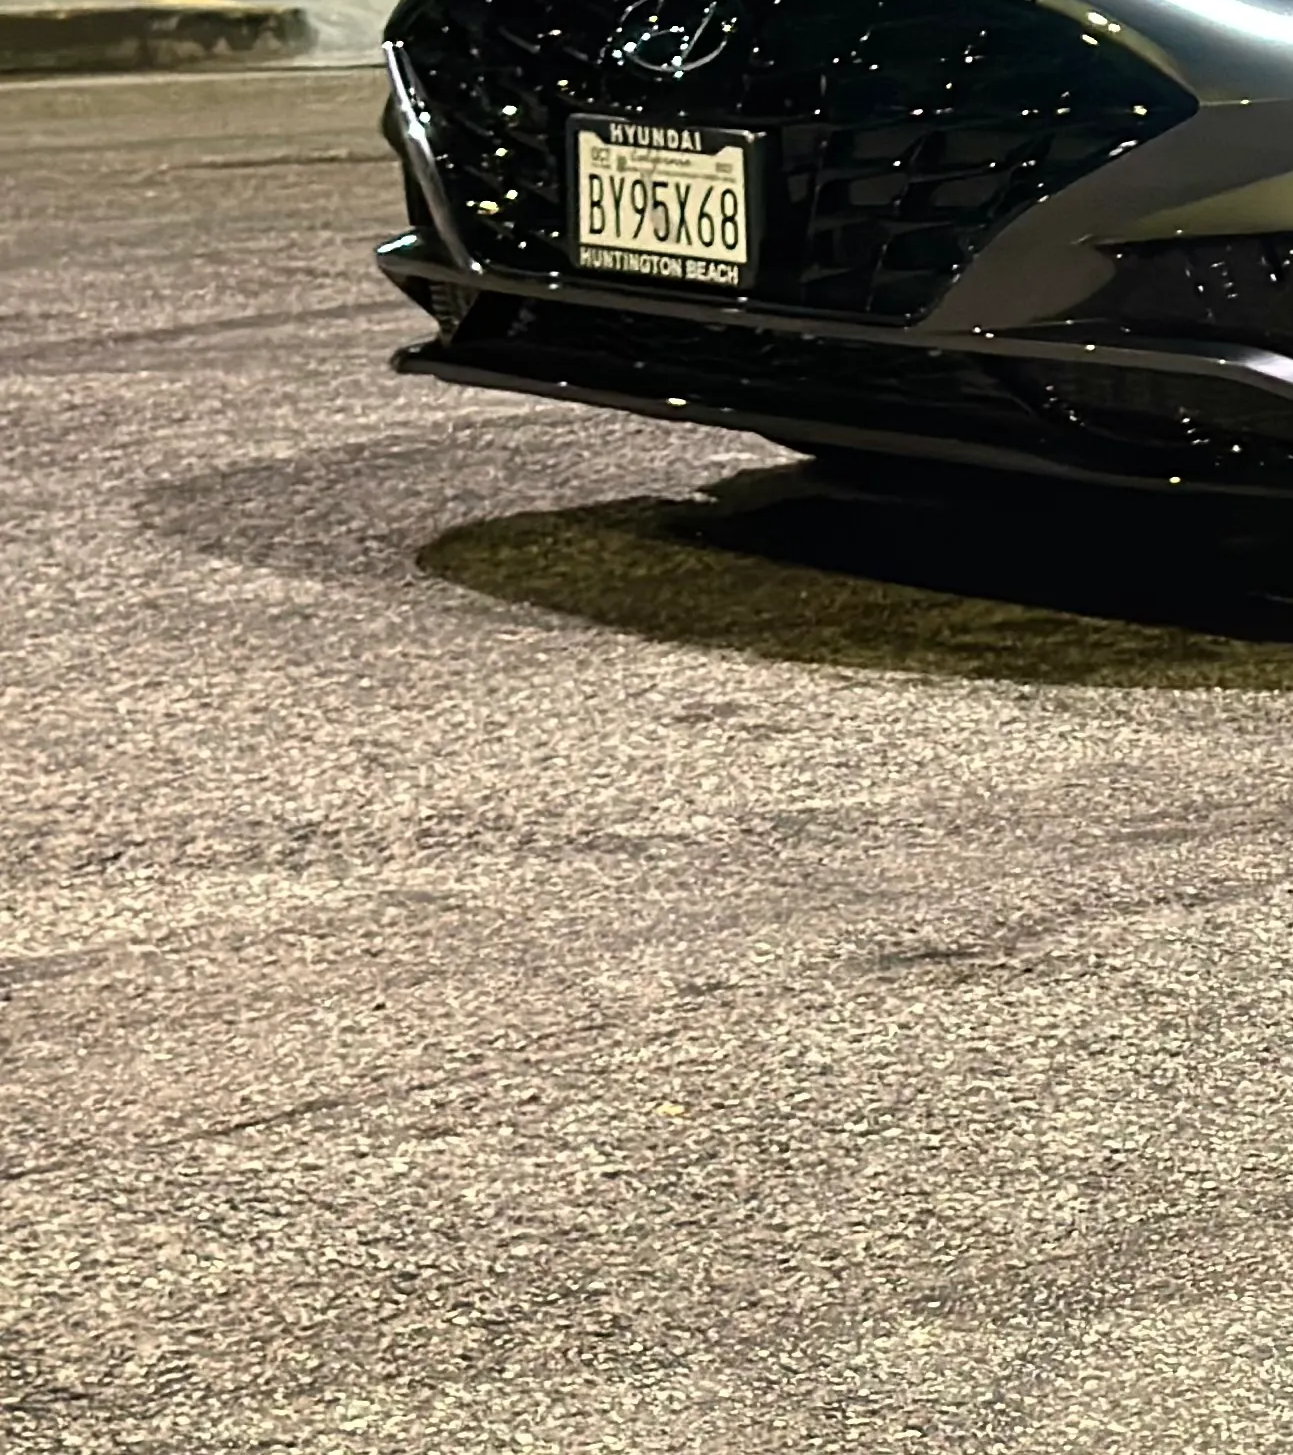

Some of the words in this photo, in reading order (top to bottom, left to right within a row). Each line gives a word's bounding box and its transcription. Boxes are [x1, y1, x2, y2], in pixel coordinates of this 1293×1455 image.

[609, 123, 703, 152] HYUNDAI
[588, 173, 739, 251] BY95X68
[580, 246, 683, 279] HUNTINGTON
[686, 261, 740, 286] BEACH
